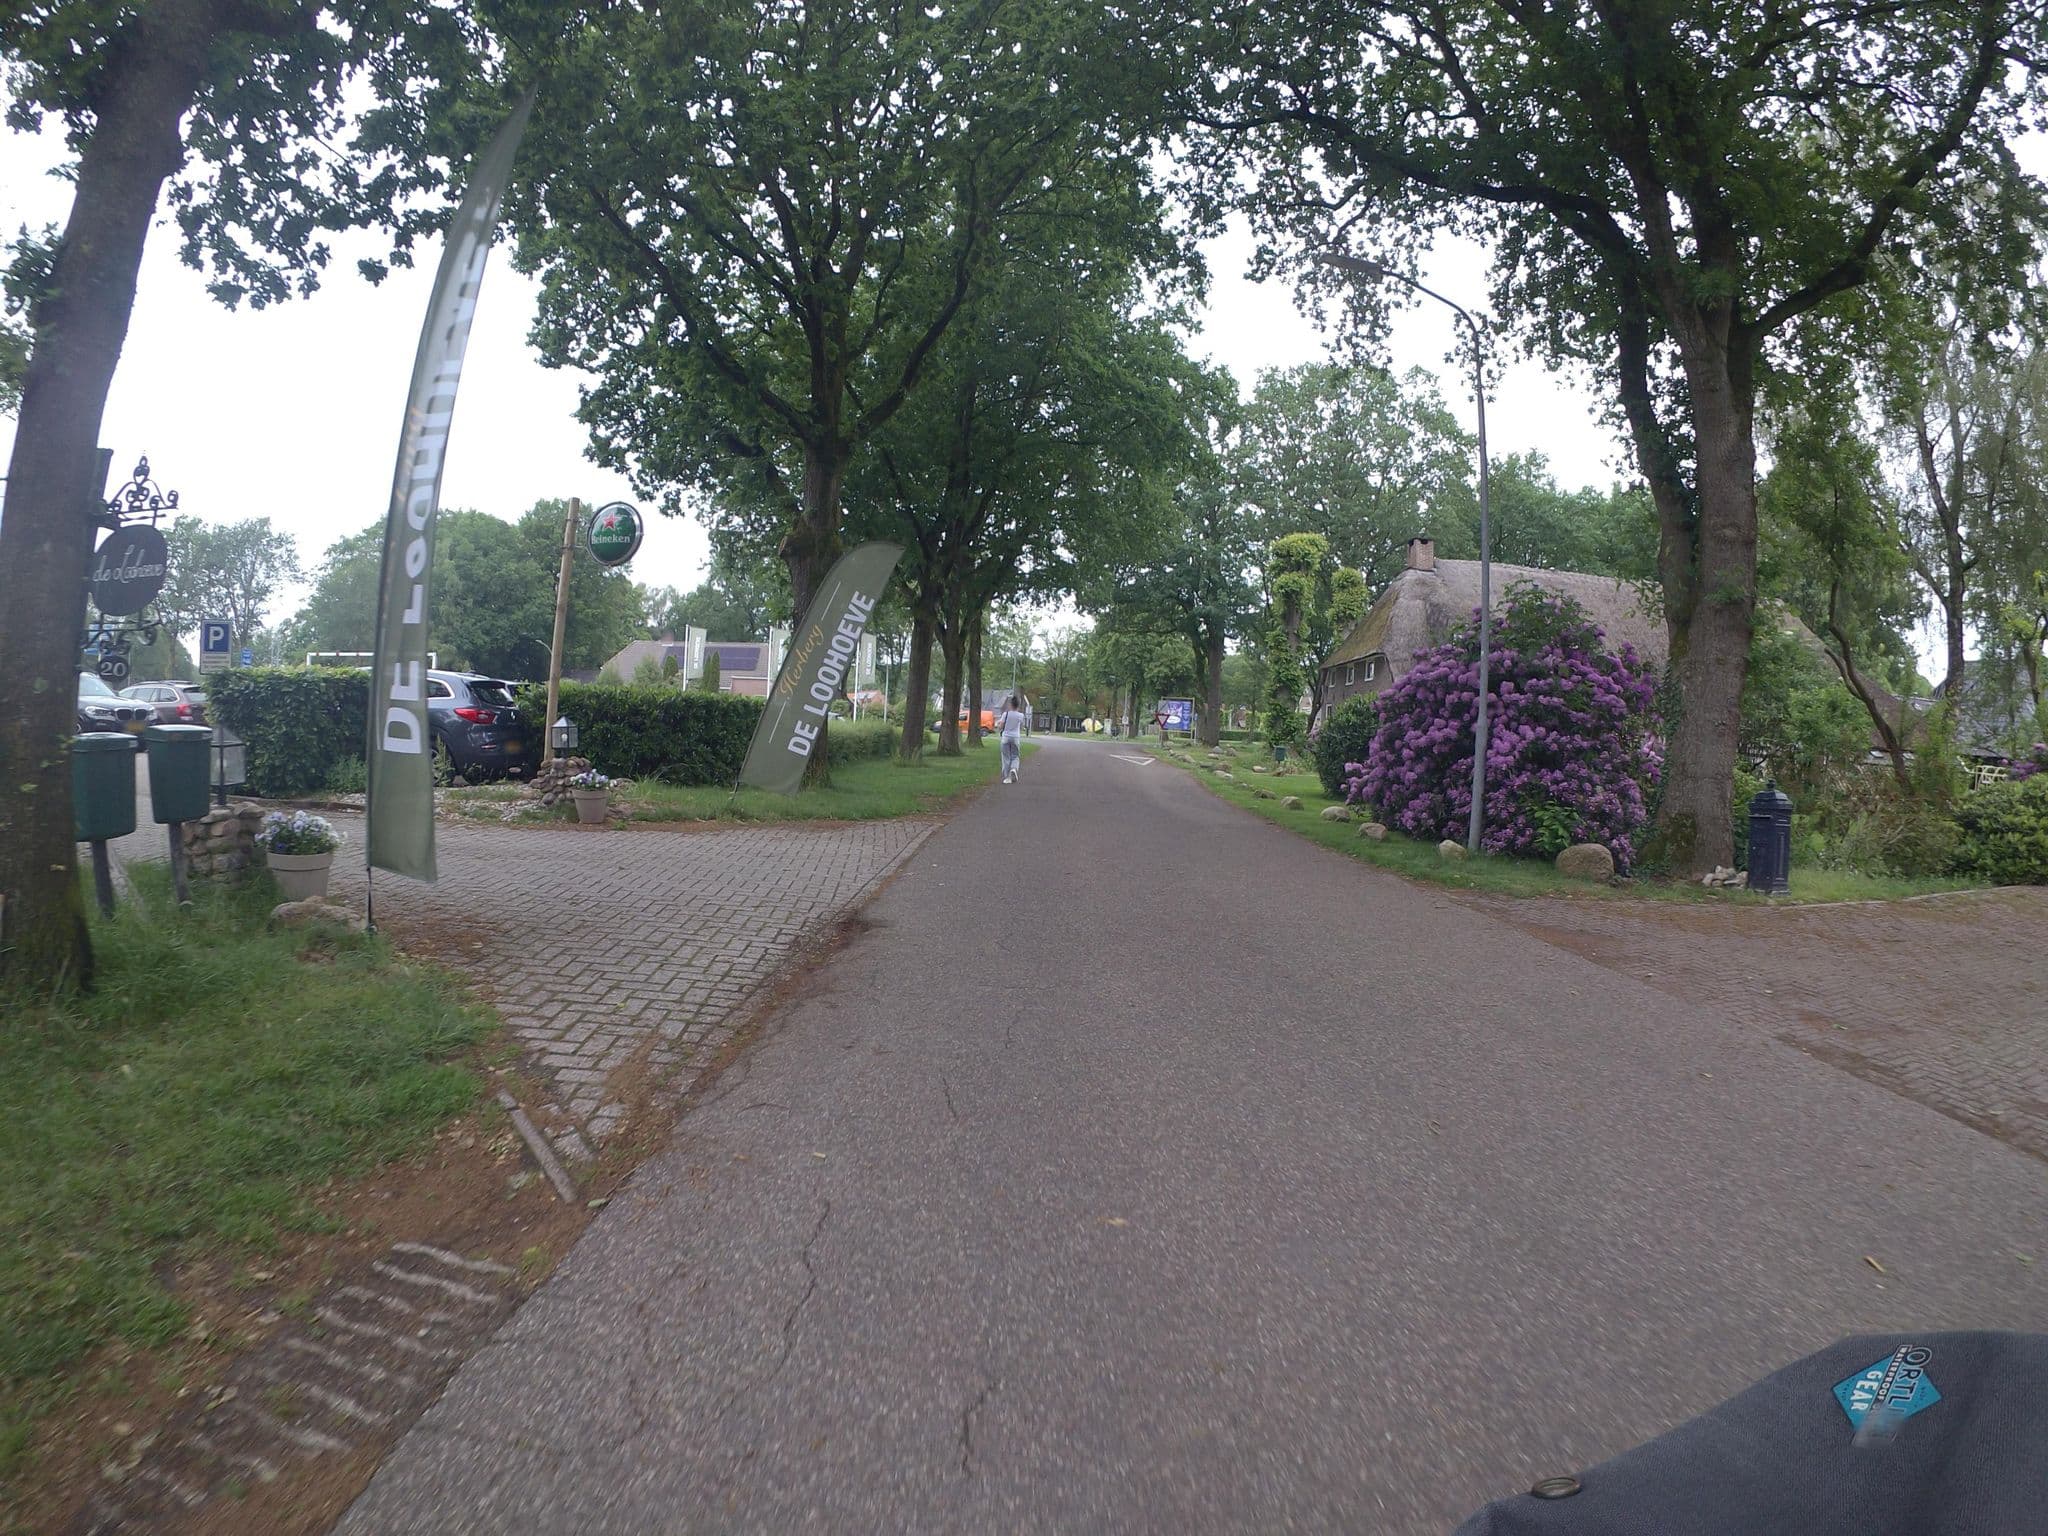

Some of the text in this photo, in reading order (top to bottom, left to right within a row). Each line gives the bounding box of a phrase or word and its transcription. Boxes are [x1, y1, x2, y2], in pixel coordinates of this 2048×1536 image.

[208, 626, 225, 650] P
[780, 623, 825, 697] Herberg
[101, 661, 127, 677] 20
[788, 590, 875, 757] DE LOOHOEVE
[383, 660, 422, 754] DE
[1850, 1370, 1883, 1411] GEAR
